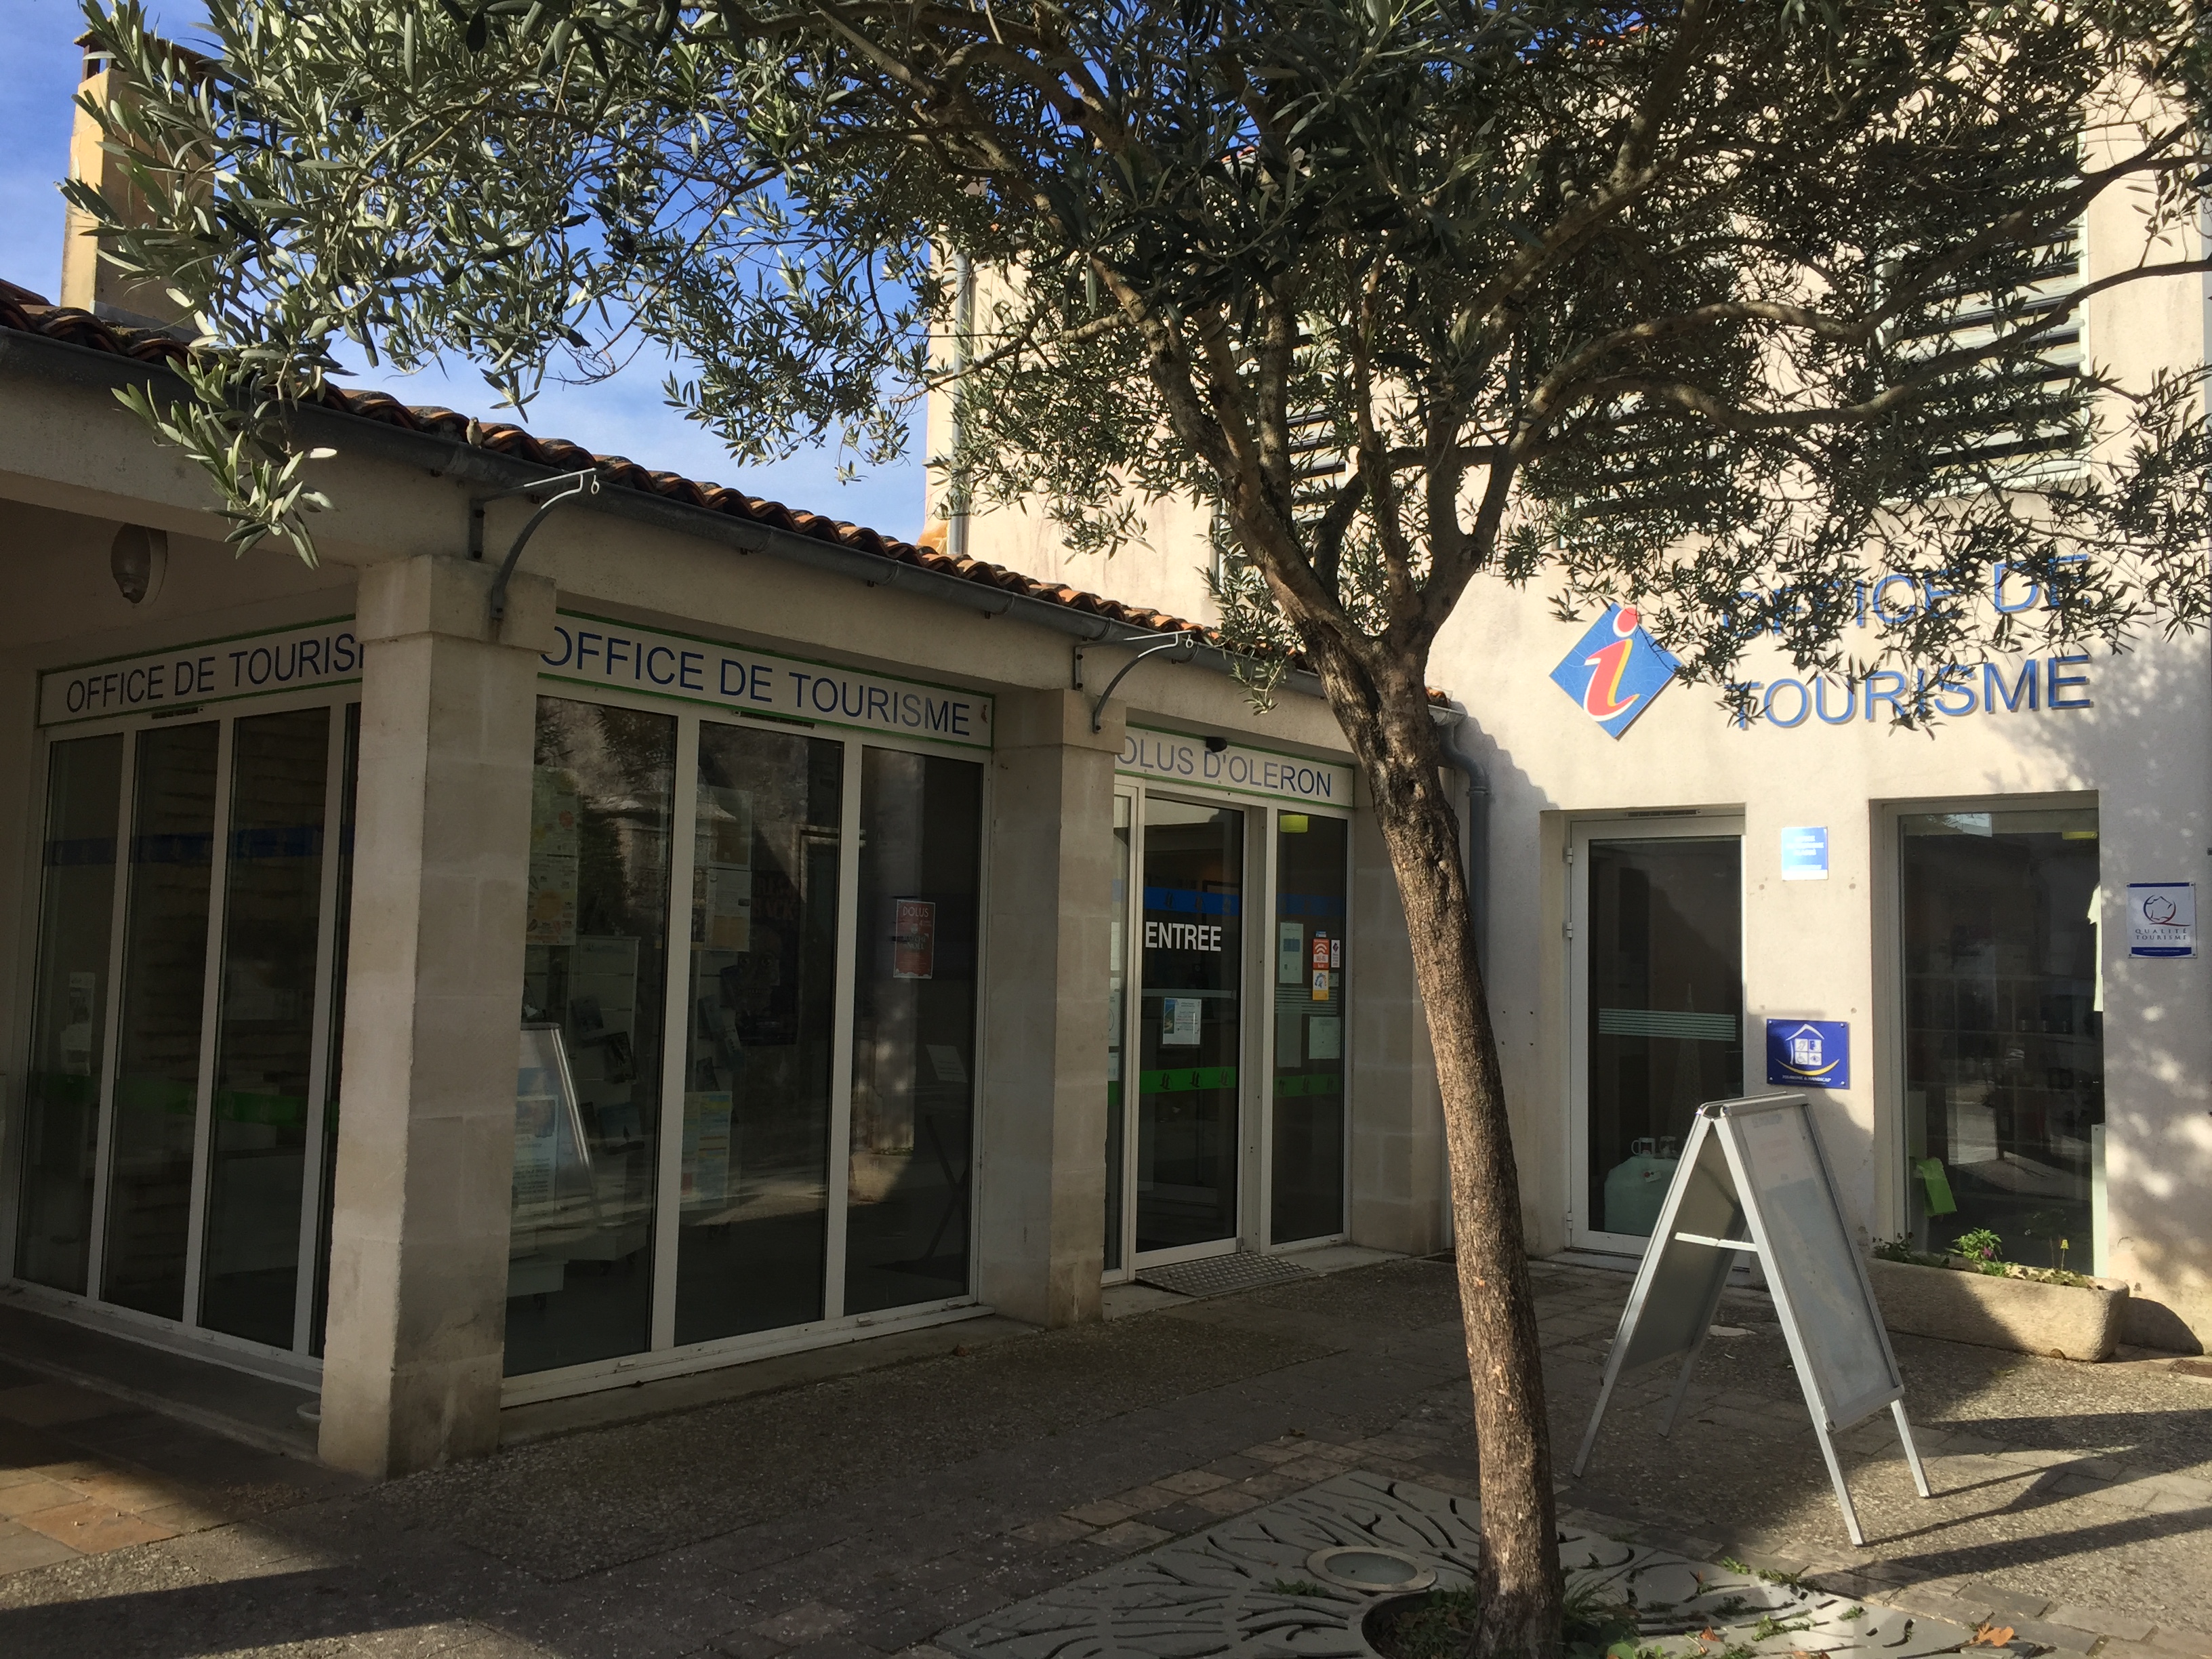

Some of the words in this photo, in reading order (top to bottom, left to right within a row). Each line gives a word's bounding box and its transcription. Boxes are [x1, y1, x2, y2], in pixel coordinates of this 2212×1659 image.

[66, 664, 165, 713] OFFICE
[174, 656, 216, 697] DE
[228, 633, 364, 687] TOURIS
[540, 626, 704, 691] OFFICE
[720, 658, 773, 703] DE
[788, 672, 970, 737] TOURISME
[1724, 655, 2091, 730] TOURISME
[1203, 750, 1332, 798] D'OLERON
[903, 906, 929, 918] DOLUS
[1145, 921, 1222, 951] ENTREE
